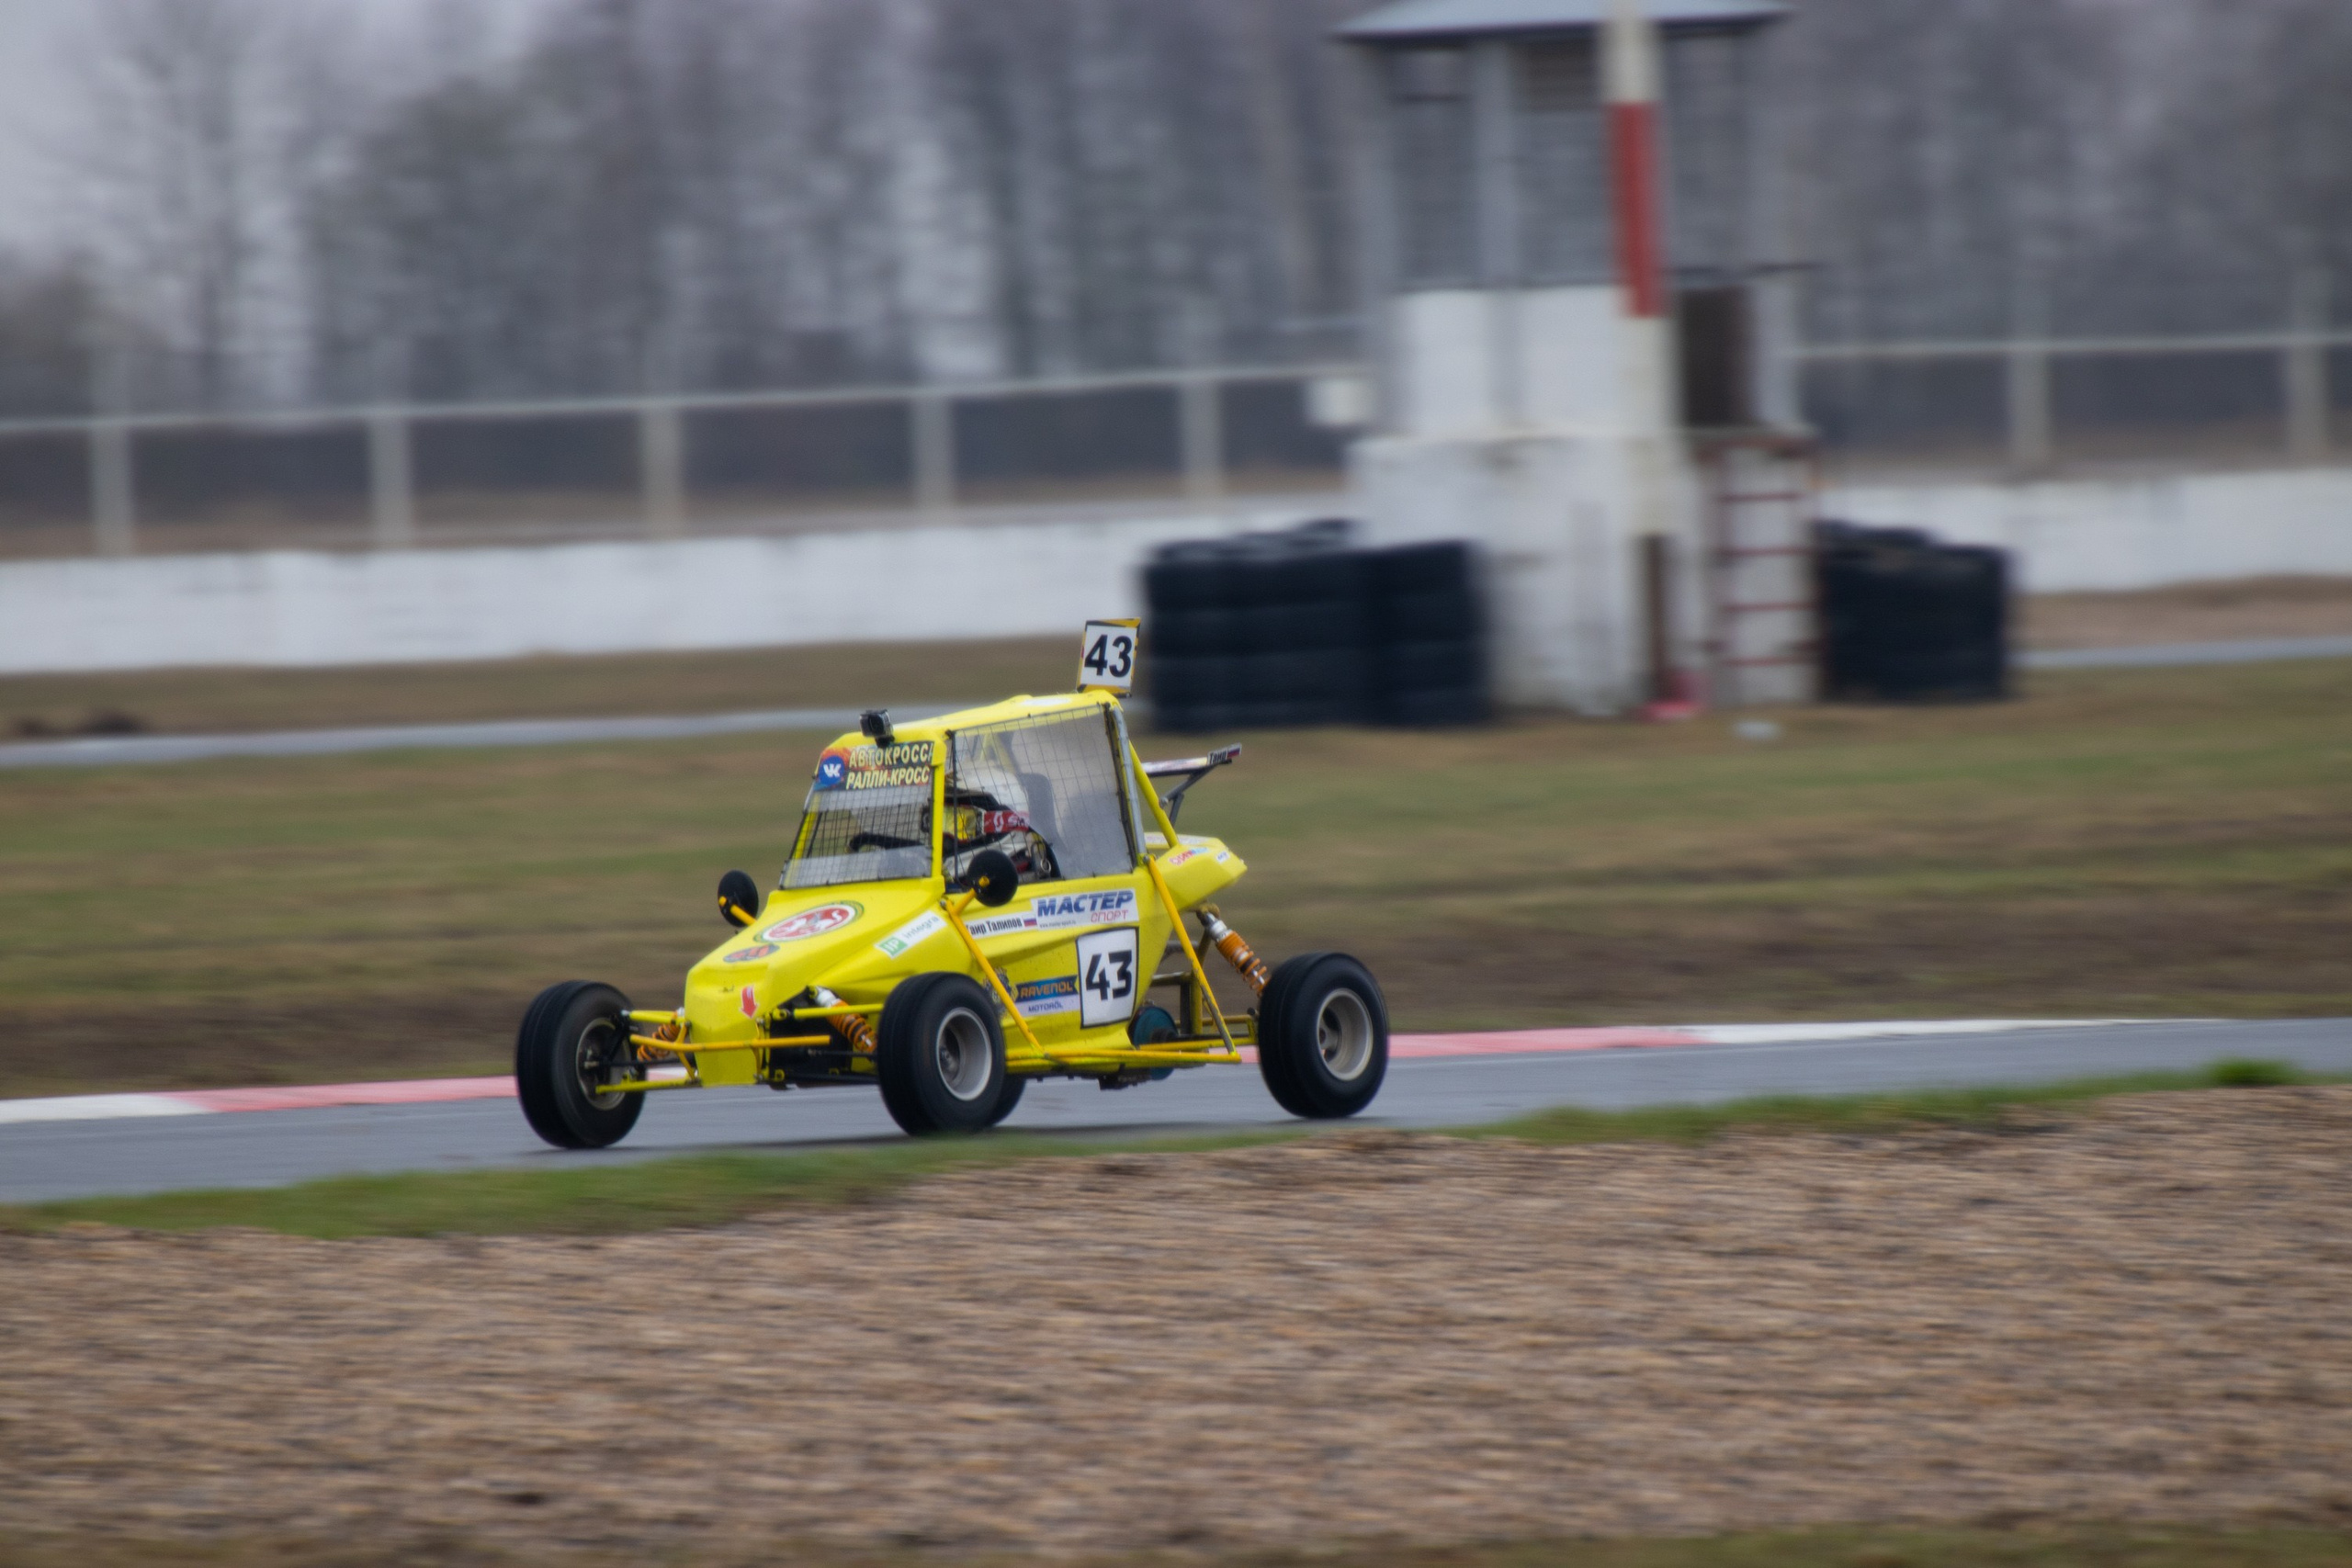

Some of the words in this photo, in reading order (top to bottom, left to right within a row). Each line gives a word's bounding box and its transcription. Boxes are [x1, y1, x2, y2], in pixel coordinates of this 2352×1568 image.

[1084, 634, 1132, 678] 43
[846, 765, 930, 790] РАЛЛИ-КРОСС
[1037, 890, 1134, 917] МАСТЕР
[1091, 908, 1129, 923] СПОРТ
[986, 917, 1023, 932] Талипов
[1085, 950, 1133, 1001] 43
[1020, 981, 1073, 998] RAVENOL
